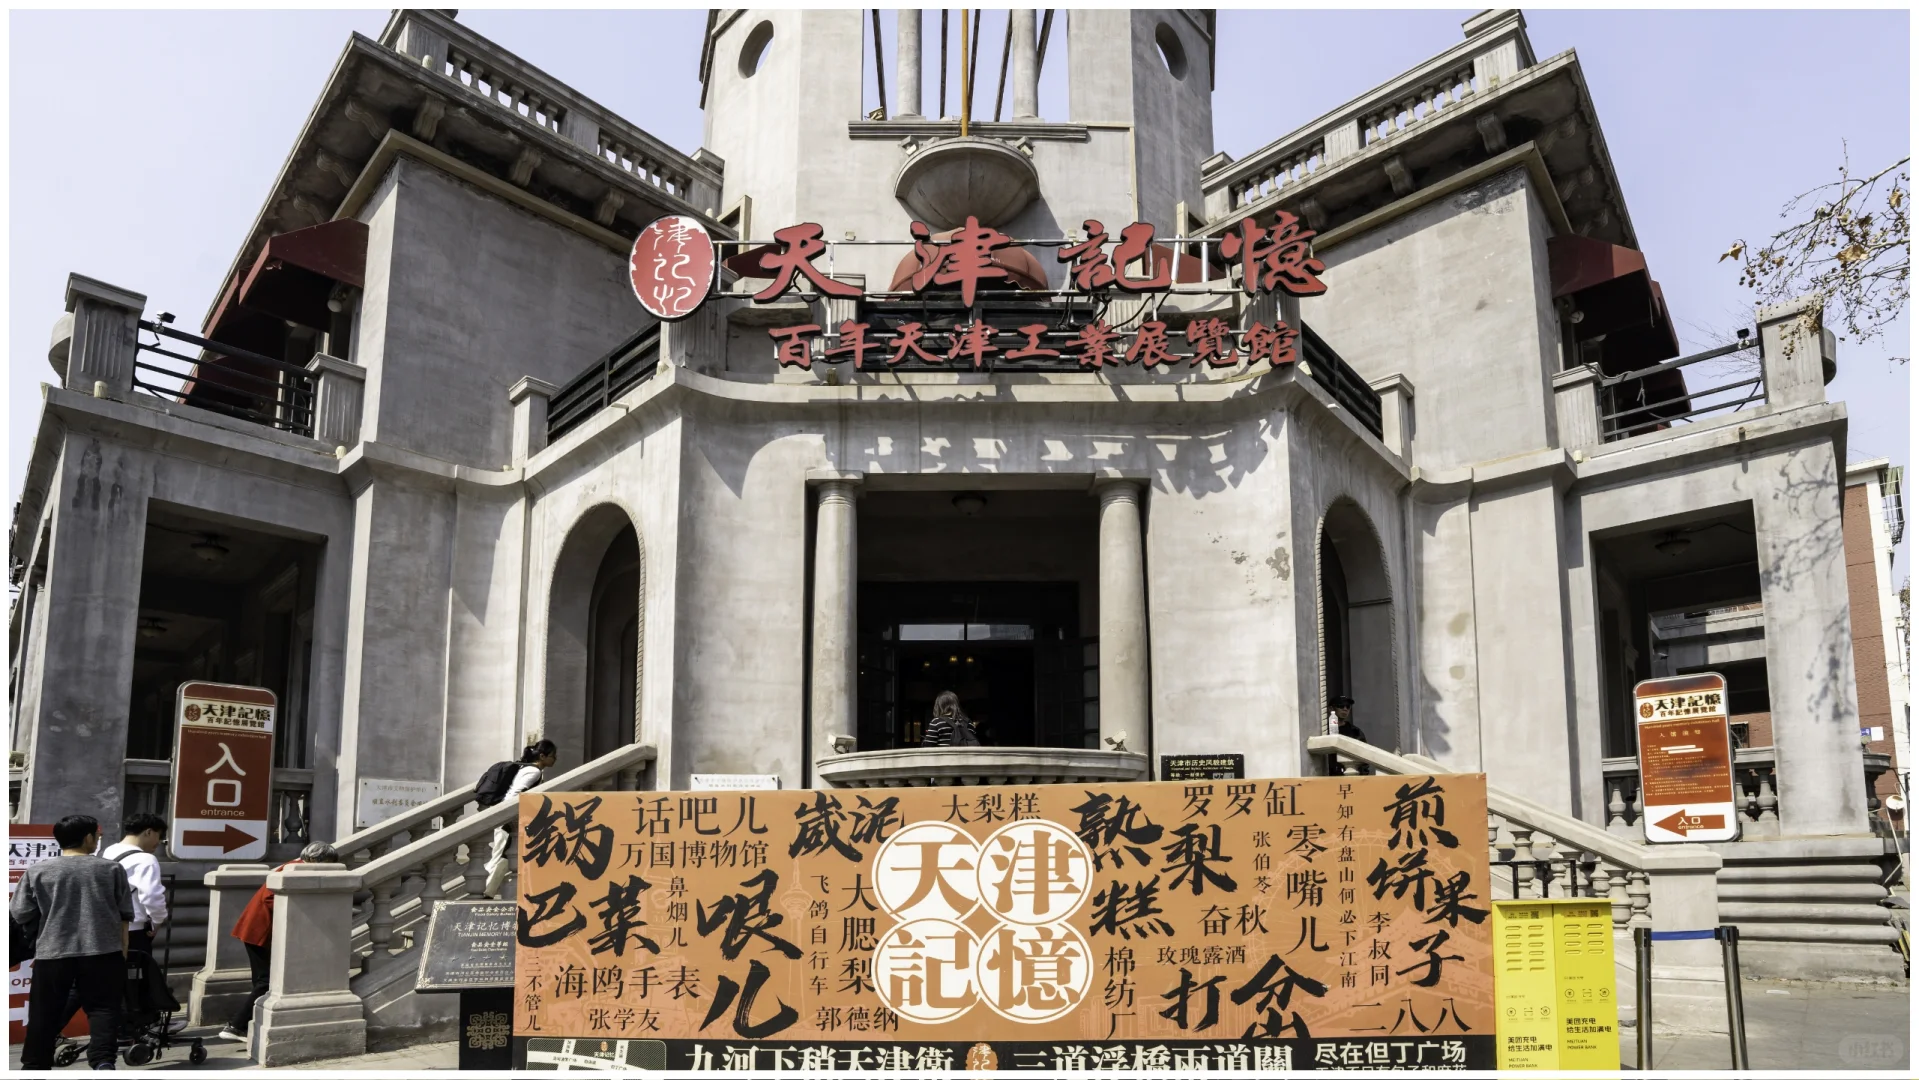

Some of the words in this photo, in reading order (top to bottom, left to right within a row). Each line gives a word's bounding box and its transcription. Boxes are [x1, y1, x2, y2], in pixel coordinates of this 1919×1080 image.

[753, 210, 1327, 307] 天津記憶
[768, 318, 1301, 370] 百年天津工業展覽館
[202, 703, 271, 721] 天津記憶
[205, 742, 247, 807] 入口
[200, 808, 245, 817] entrance
[631, 796, 769, 838] 话吧儿
[943, 793, 1041, 823] 大梨糕
[1181, 782, 1306, 822] 罗罗缸
[1677, 817, 1700, 825] 入口
[619, 840, 769, 869] 万国博物馆
[1252, 831, 1272, 894] 张伯苓
[1285, 823, 1330, 956] 零嘴儿
[1336, 784, 1357, 989] 早知有盘山何必下江南
[665, 875, 689, 948] 鼻烟儿
[1197, 903, 1269, 937] 奋秋
[696, 868, 804, 1038] 哏儿
[808, 875, 830, 996] 飞鸽自行车
[1156, 945, 1247, 966] 玫瑰露酒
[1368, 911, 1392, 987] 李叔同
[523, 956, 543, 1032] 三不管儿
[554, 965, 701, 1000] 海鸥手表
[1102, 946, 1137, 1041] 棉纺厂
[589, 1008, 661, 1032] 张学友
[815, 1006, 900, 1032] 郭德纲
[1349, 998, 1473, 1034] 二八八
[1315, 1041, 1466, 1065] 尽在但丁广场
[1508, 1044, 1553, 1052] 给生活加满电
